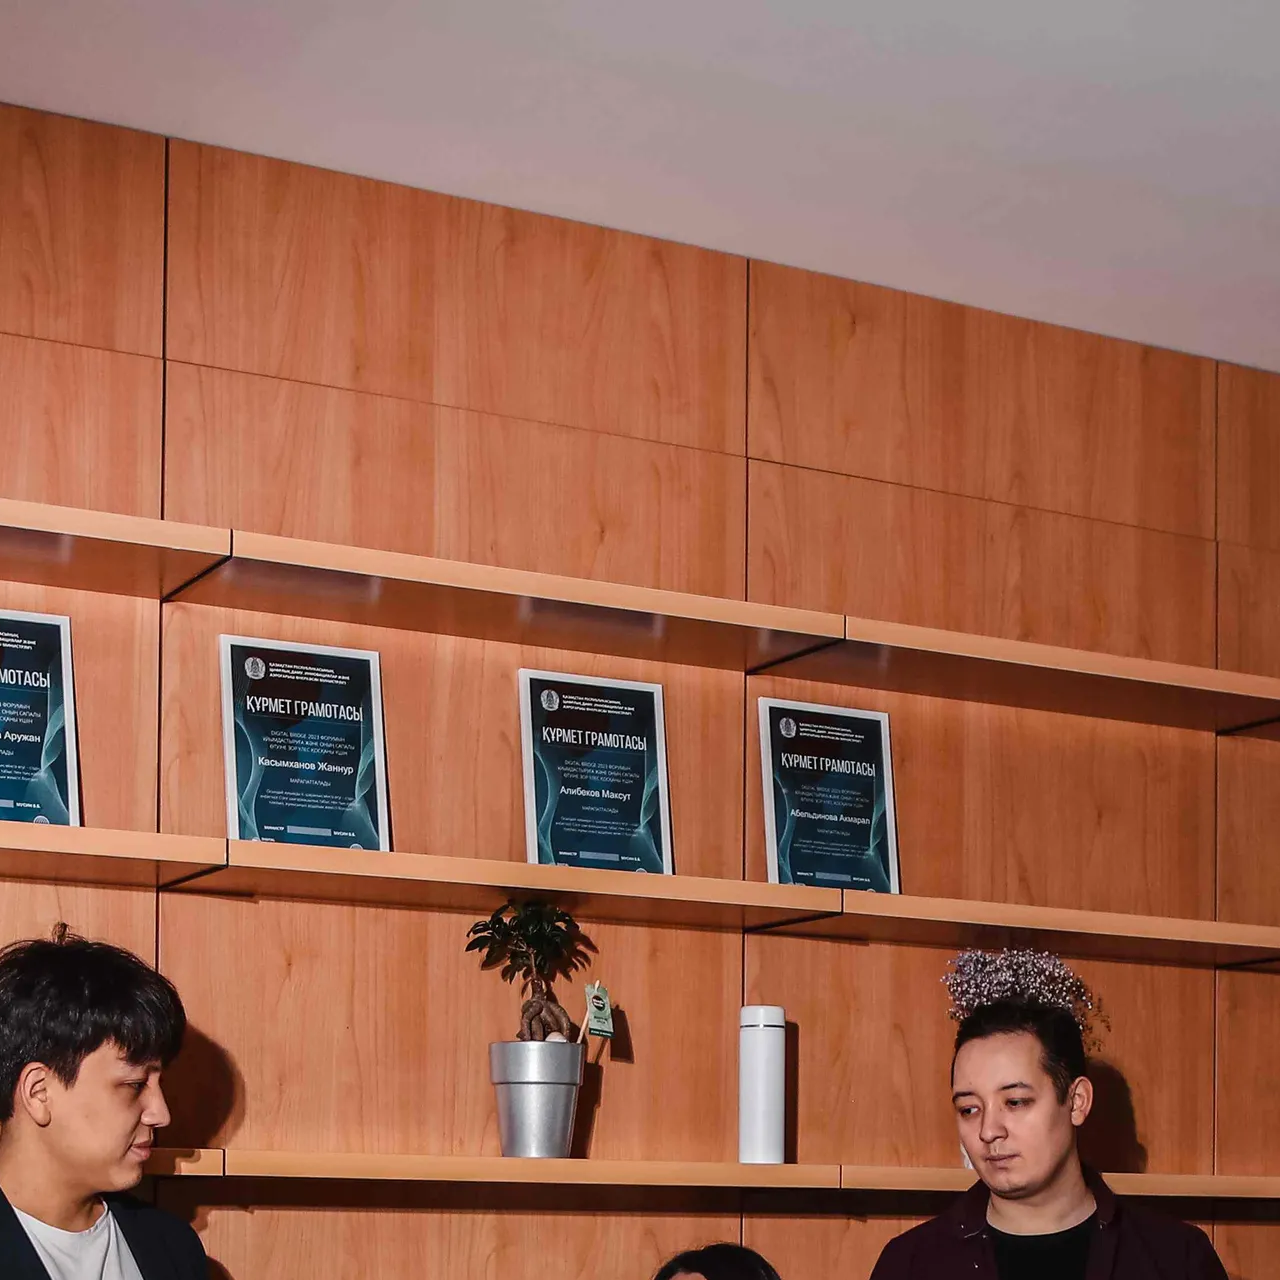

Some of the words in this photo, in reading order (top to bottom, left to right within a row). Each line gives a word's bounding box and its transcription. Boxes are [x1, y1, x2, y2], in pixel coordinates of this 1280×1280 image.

[246, 695, 291, 716] ҚҰРМЕТ
[294, 700, 363, 722] ГРАМОТАСЫ
[4, 731, 41, 743] Аружан
[543, 726, 583, 746] ҚҰРМЕТ
[586, 731, 647, 751] ГРАМОТАСЫ
[258, 756, 316, 770] Касымханов
[318, 762, 354, 776] Жаннур
[820, 757, 875, 777] ГРАМОТАСЫ
[560, 786, 600, 798] Алибеков
[602, 789, 631, 802] Максут
